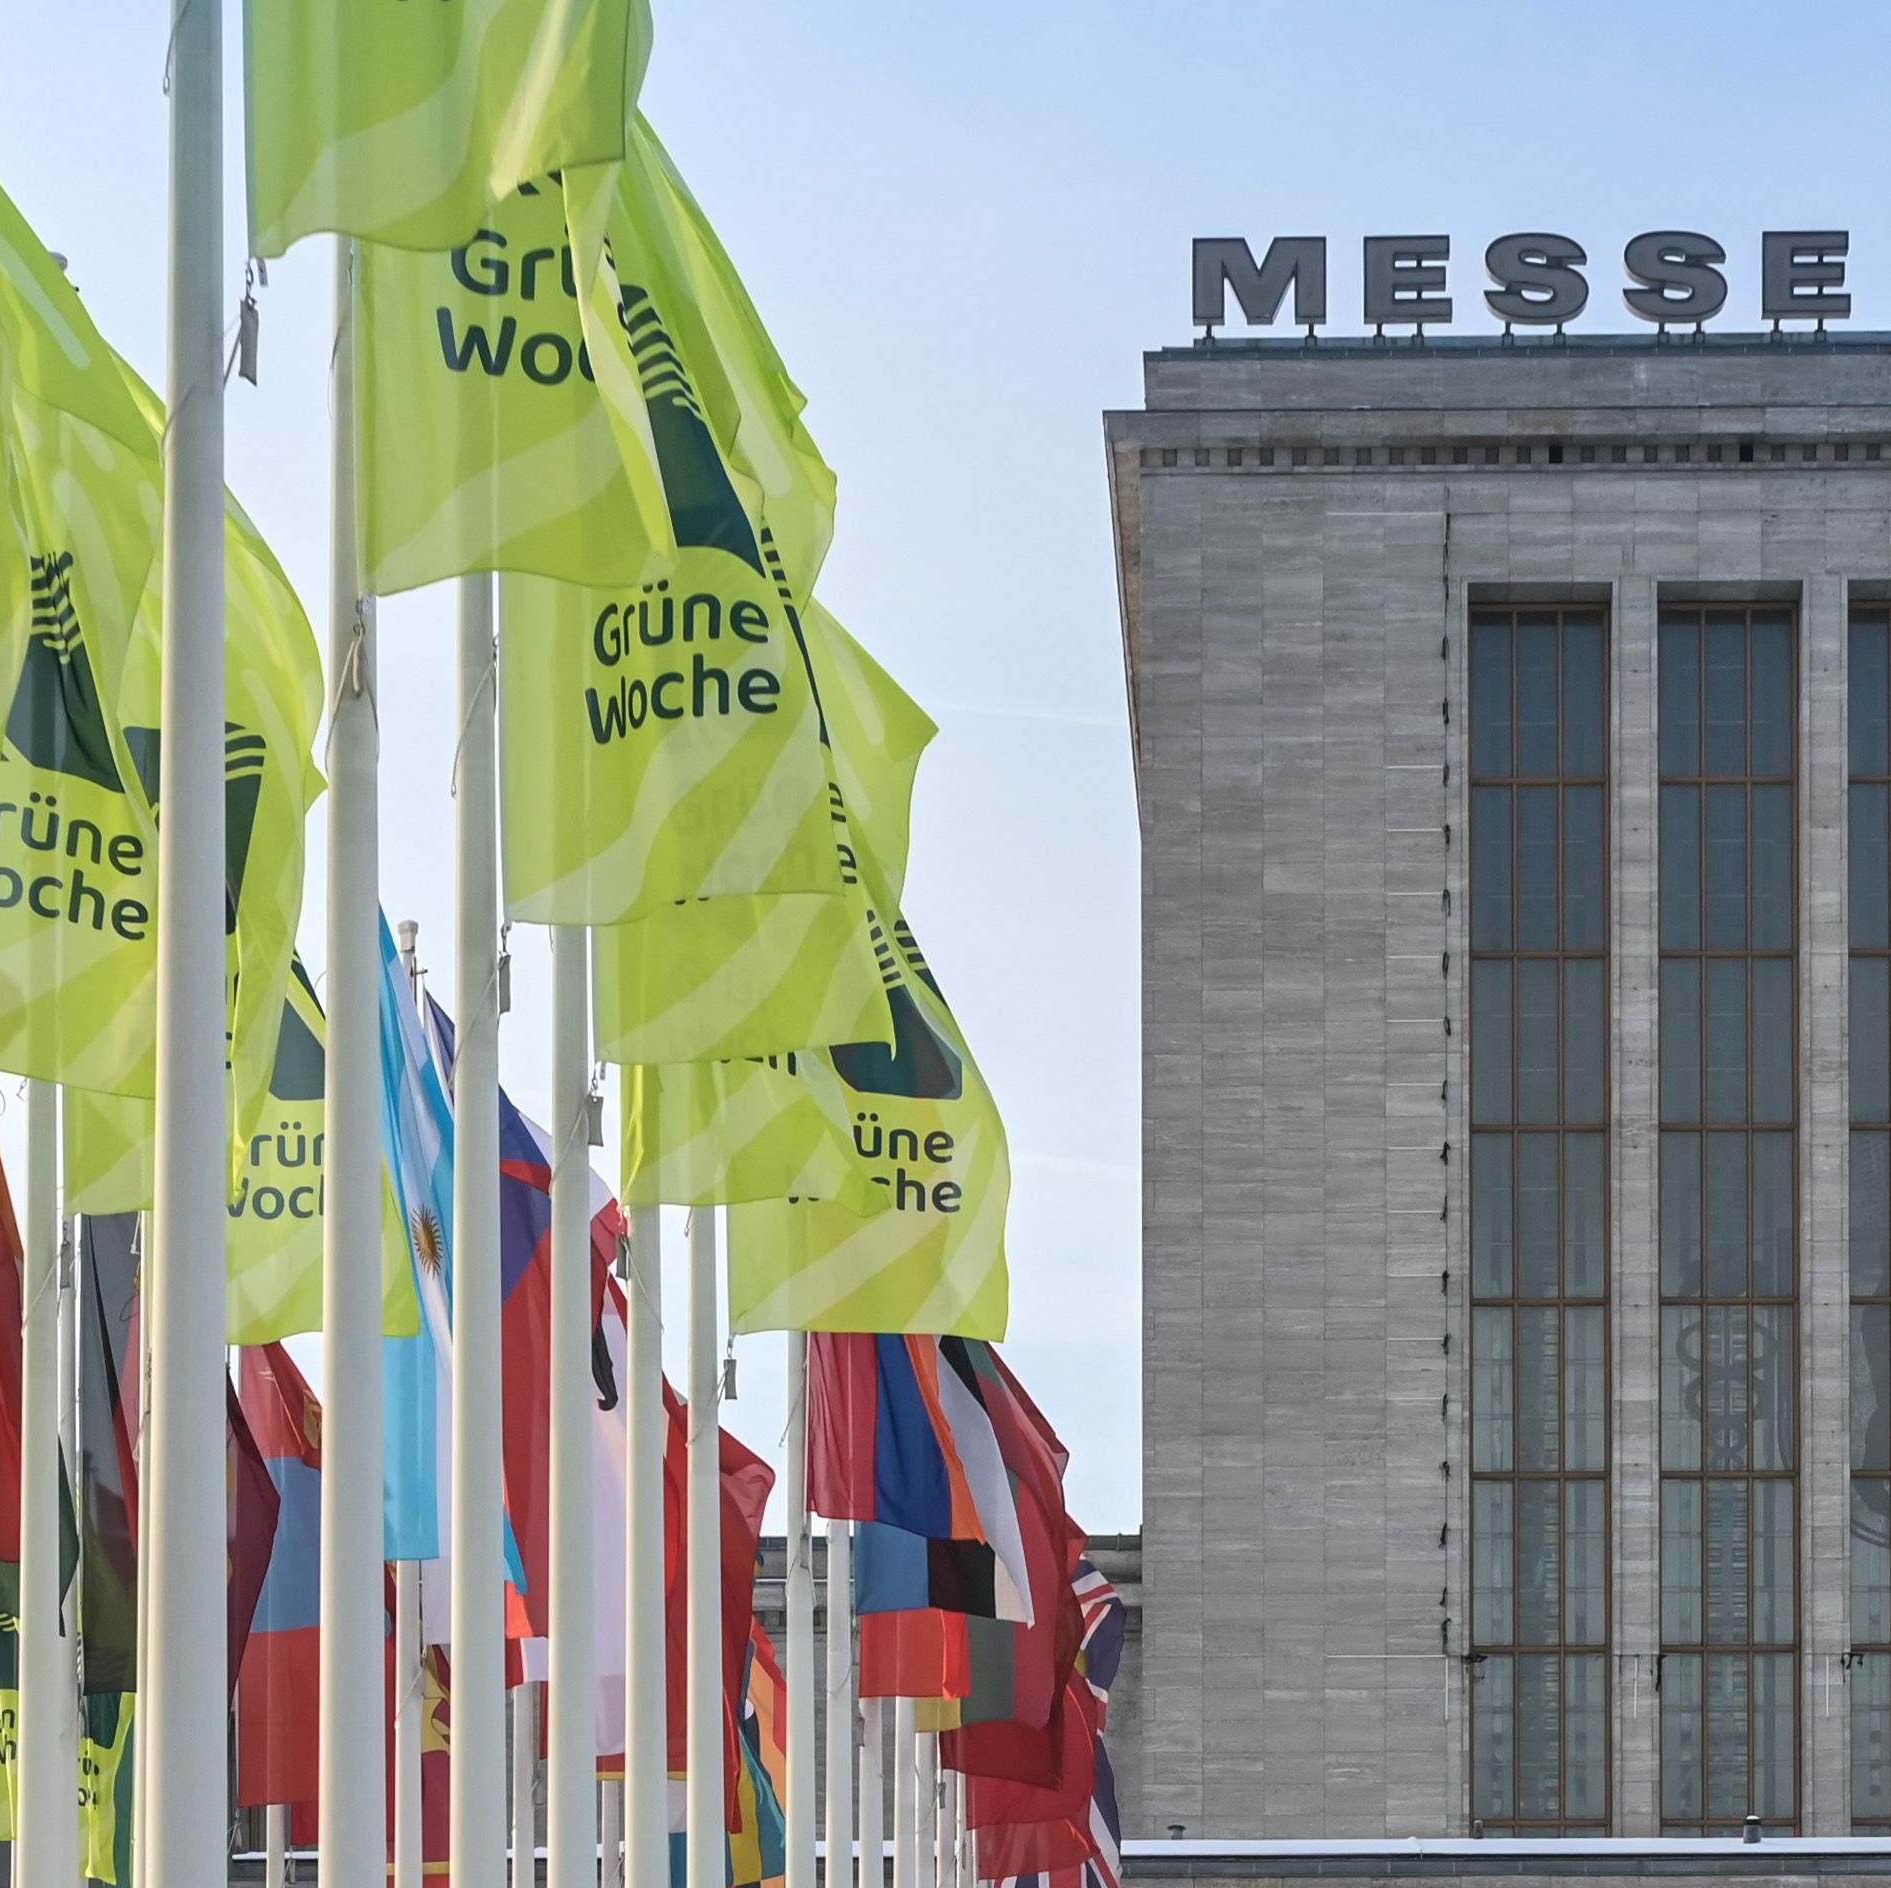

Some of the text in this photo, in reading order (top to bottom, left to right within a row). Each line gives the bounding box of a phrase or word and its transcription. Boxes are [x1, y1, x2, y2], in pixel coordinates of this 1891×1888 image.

[1193, 231, 1851, 326] MESSE
[594, 579, 770, 666] Grüne
[585, 653, 780, 744] Woche
